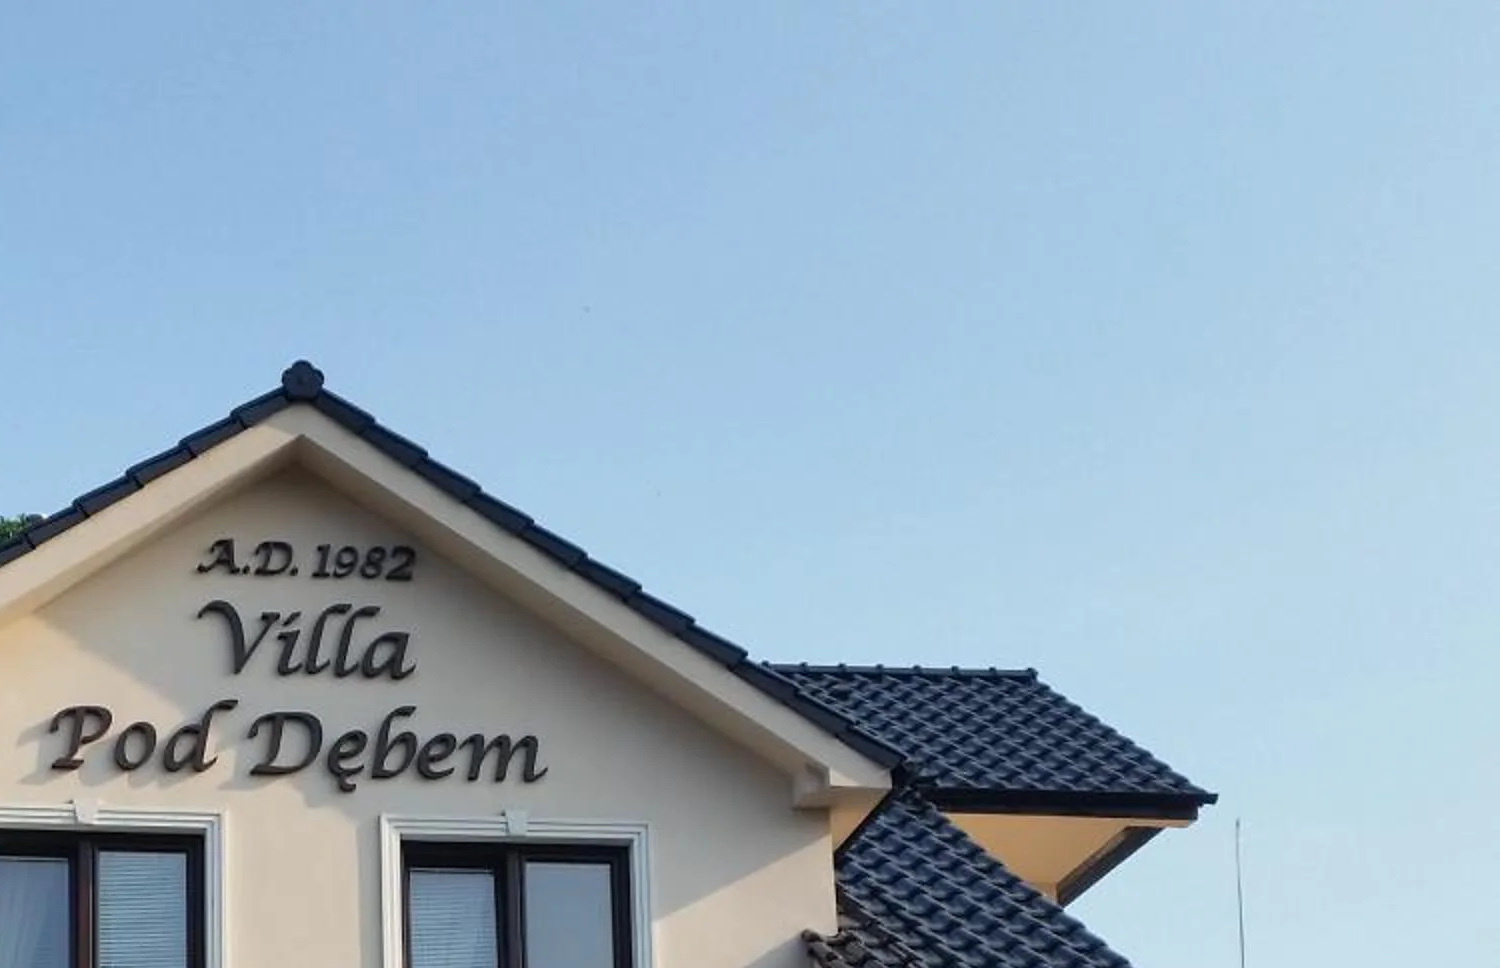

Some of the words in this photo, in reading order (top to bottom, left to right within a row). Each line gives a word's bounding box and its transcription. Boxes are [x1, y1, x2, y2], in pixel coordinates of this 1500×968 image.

[197, 538, 299, 577] A.D.
[312, 543, 416, 582] 1982
[198, 600, 417, 680] Villa
[50, 700, 238, 774] Pod
[247, 706, 548, 793] Dębem
